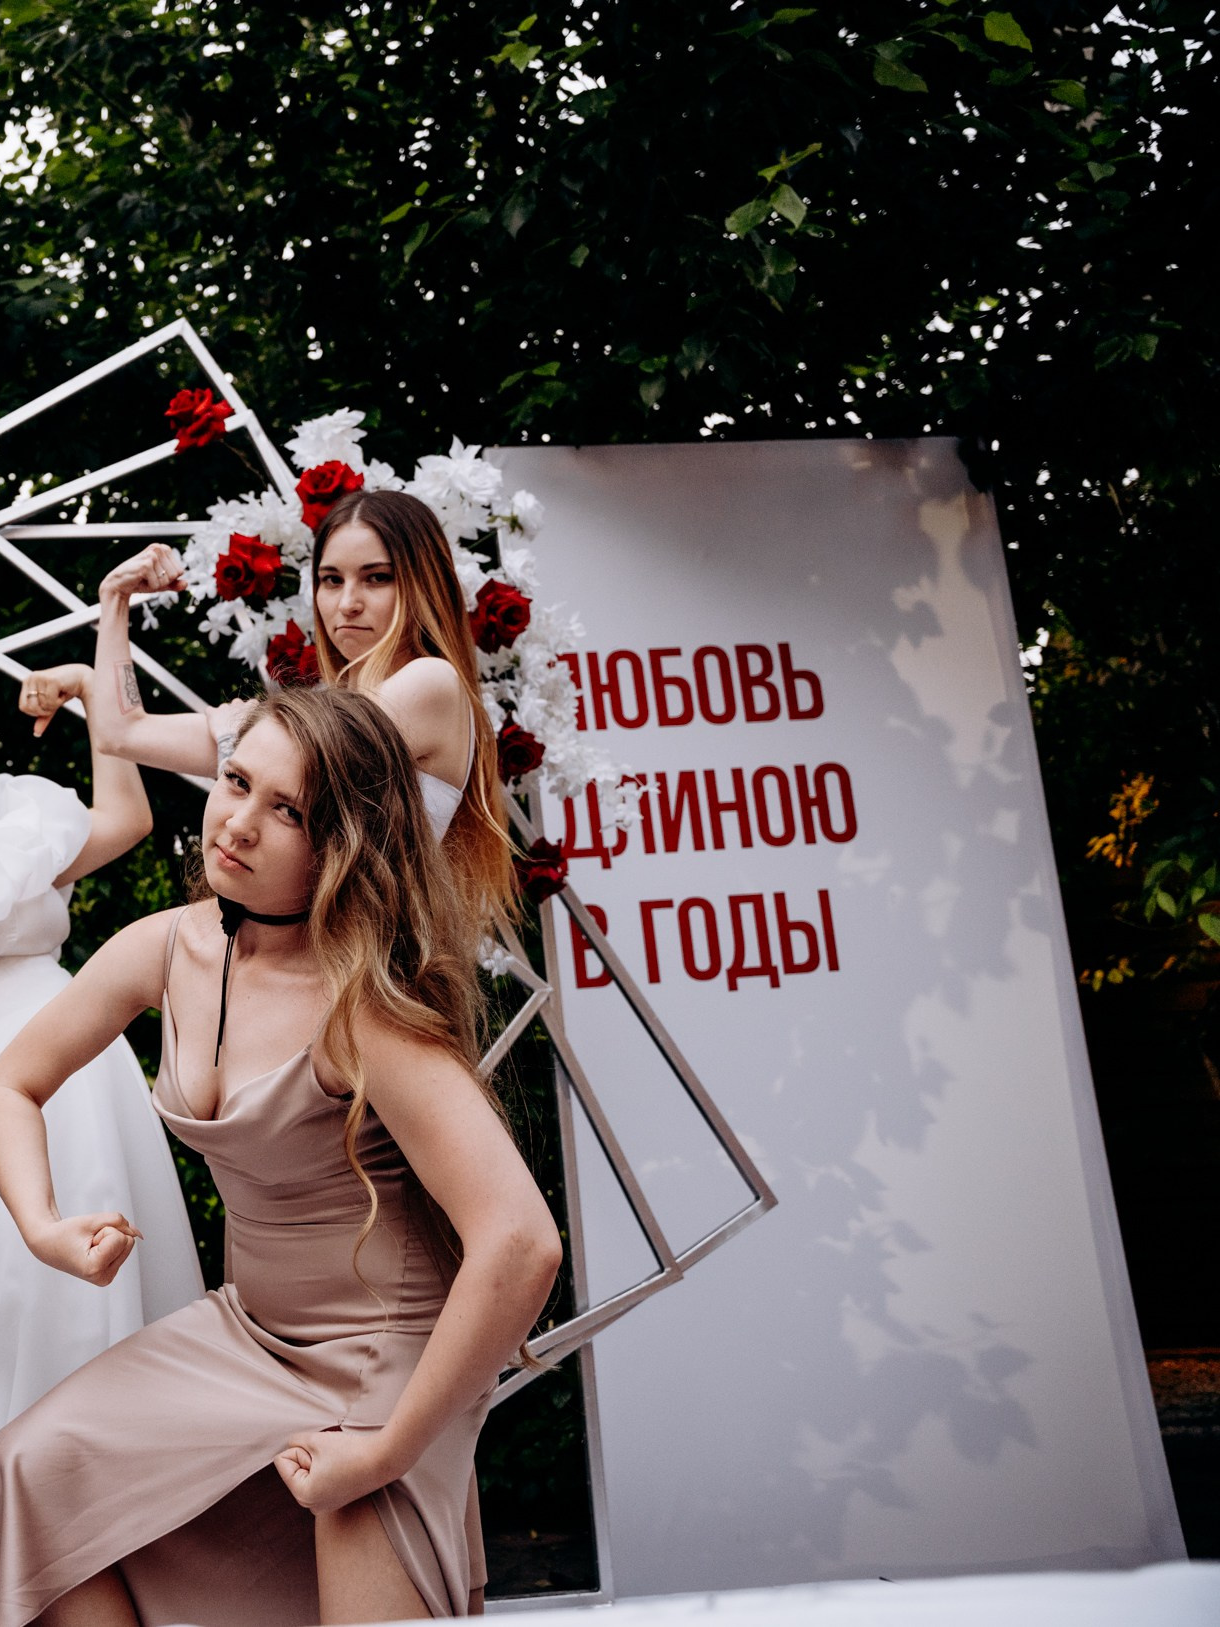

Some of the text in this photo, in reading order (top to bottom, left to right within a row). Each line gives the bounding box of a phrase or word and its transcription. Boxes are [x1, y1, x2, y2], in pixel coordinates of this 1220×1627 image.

[562, 761, 858, 870] ДЛИНОЮ
[569, 888, 840, 992] В ГОДЫ
